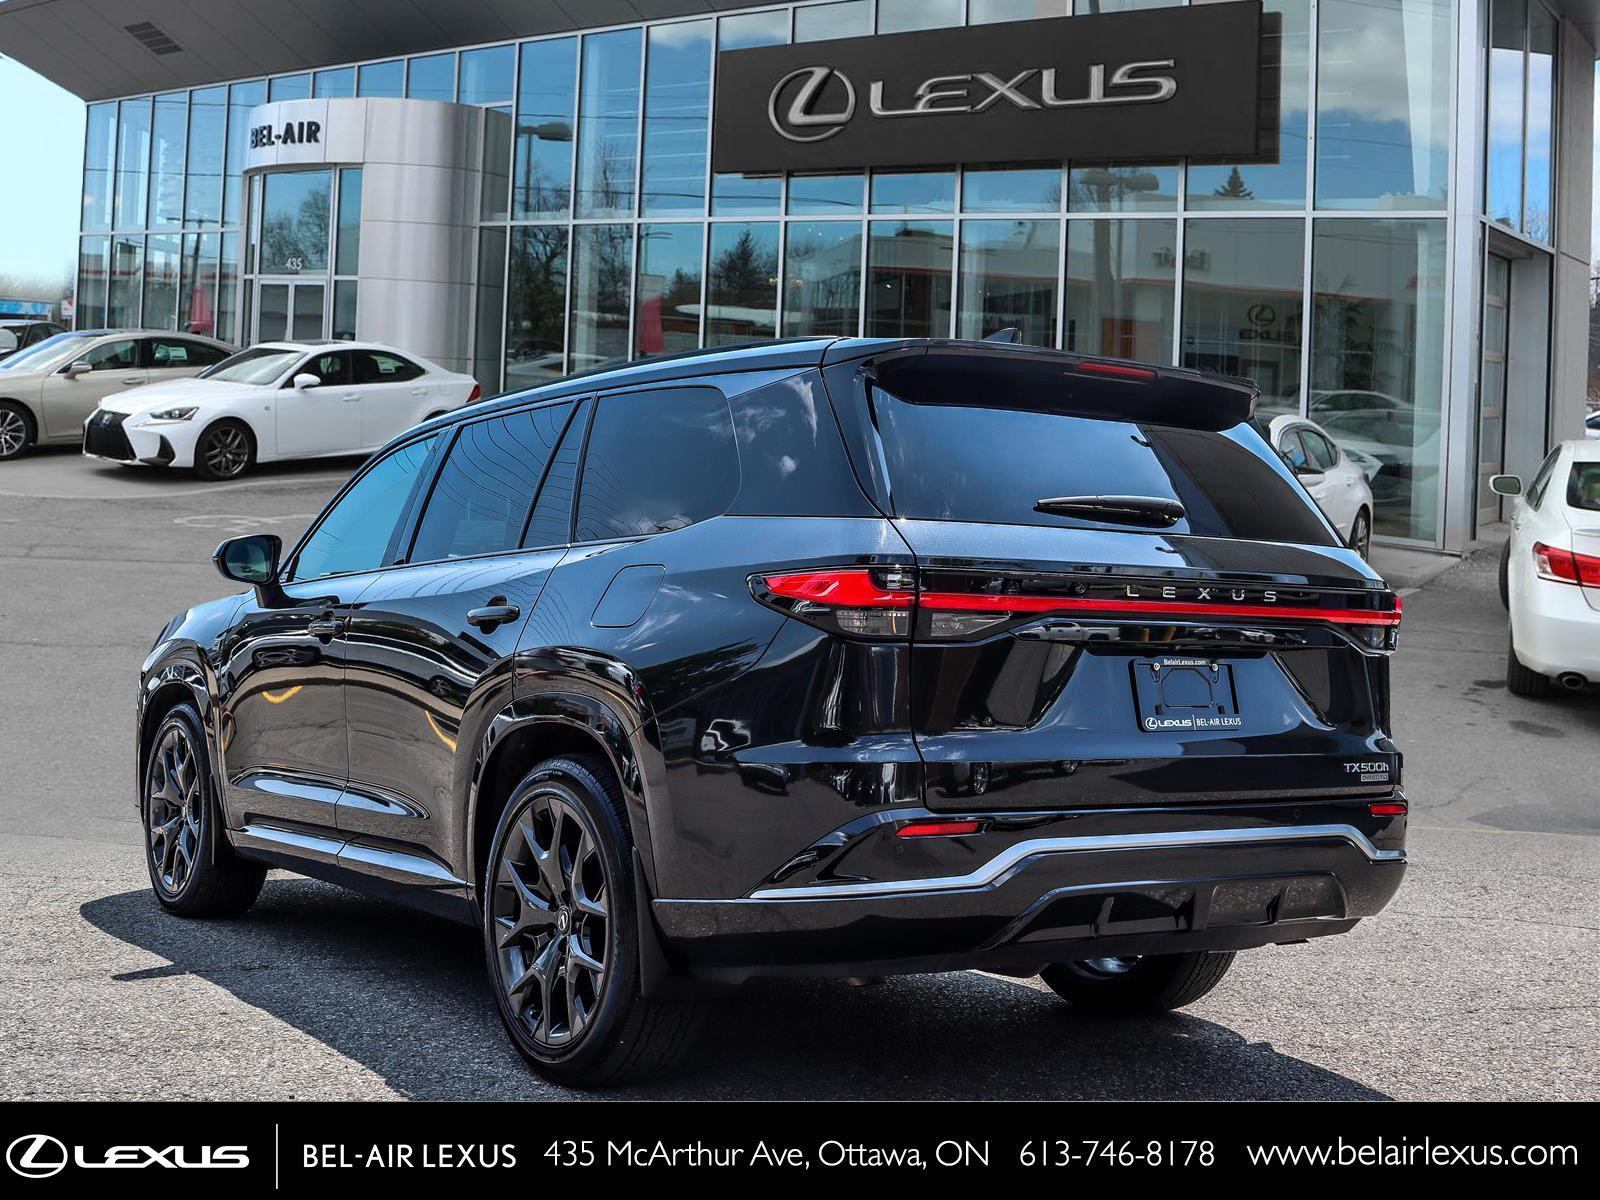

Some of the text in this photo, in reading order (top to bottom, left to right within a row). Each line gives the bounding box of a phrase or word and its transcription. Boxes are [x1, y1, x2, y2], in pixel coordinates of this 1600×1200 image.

[870, 59, 1177, 117] LEXUS
[250, 121, 321, 149] BEL-AIR
[286, 257, 302, 270] 435
[1126, 585, 1277, 602] LEXUS
[1158, 719, 1192, 727] LEXUS
[1221, 717, 1242, 726] LEXUS
[1343, 762, 1389, 773] TX500h
